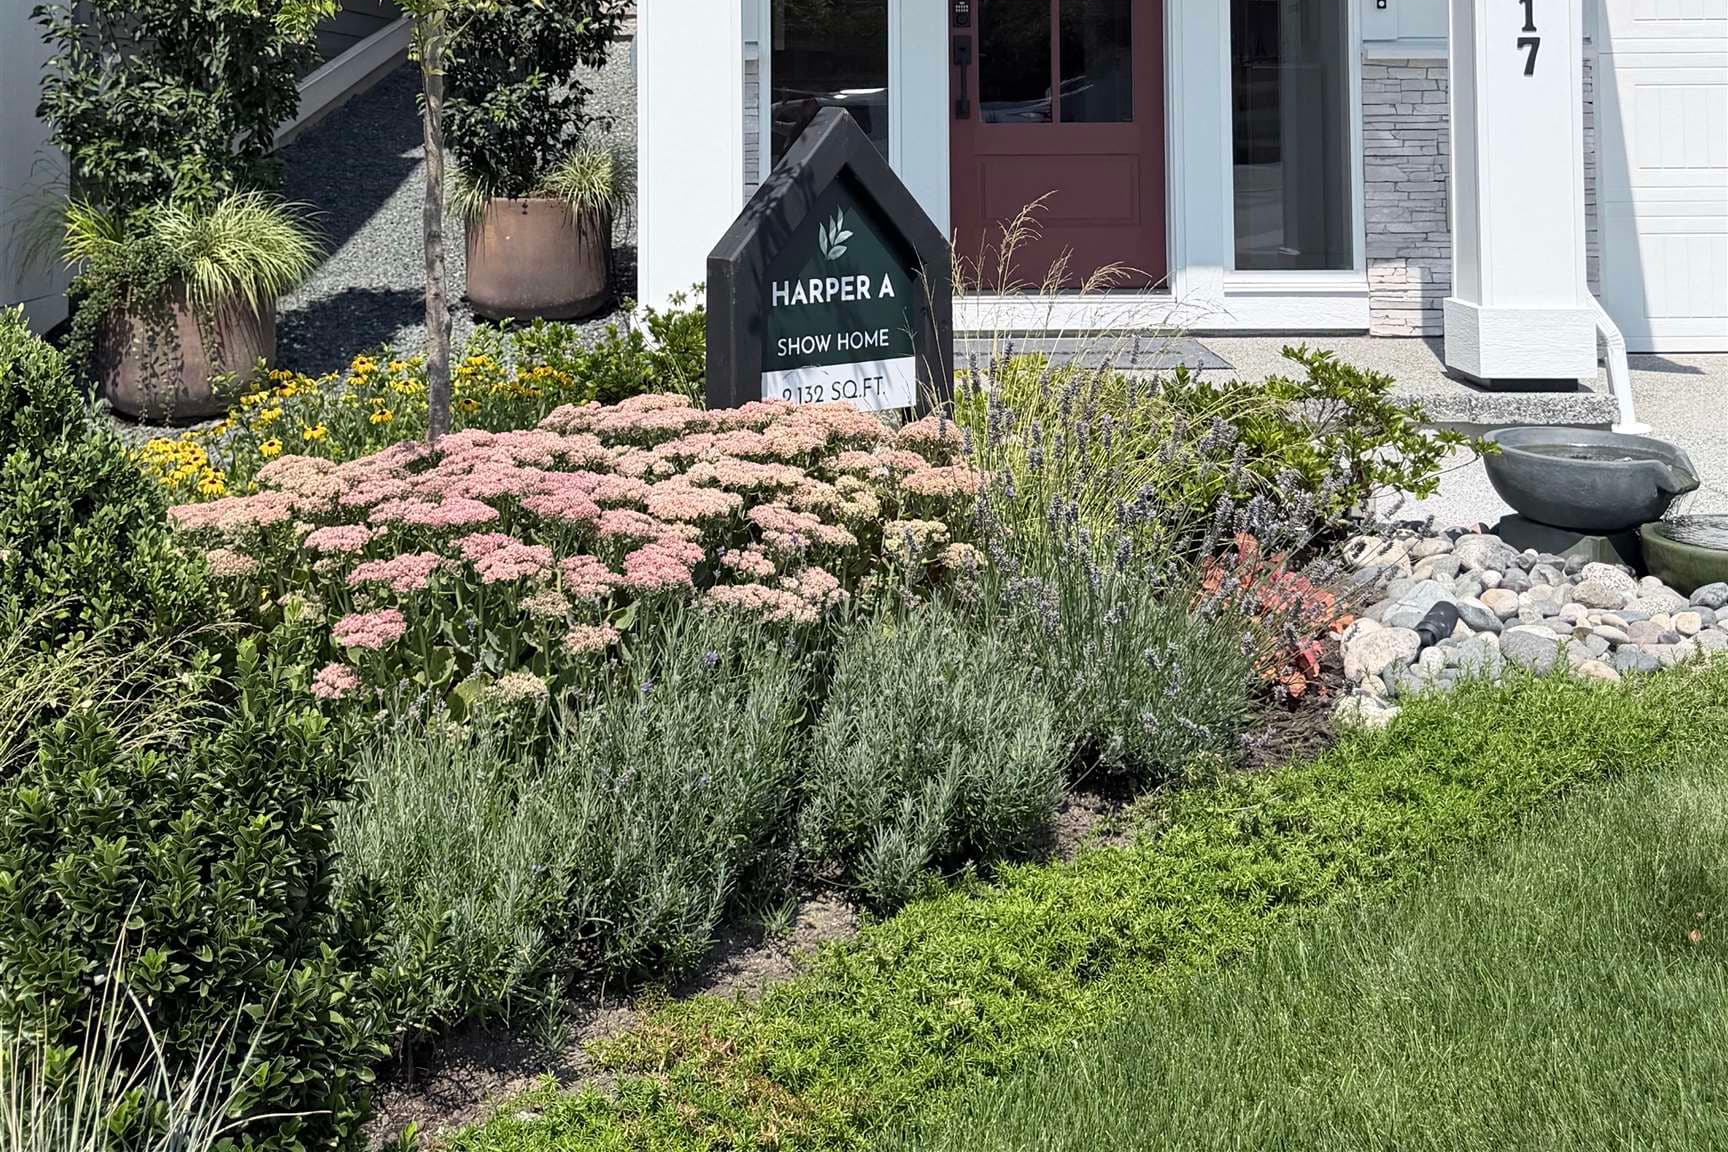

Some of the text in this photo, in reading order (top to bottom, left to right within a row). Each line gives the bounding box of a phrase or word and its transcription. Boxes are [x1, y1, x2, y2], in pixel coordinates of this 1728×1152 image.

[772, 272, 895, 306] HARPER A
[777, 329, 889, 357] SHOW HOME
[831, 376, 886, 401] SQ.FT.
